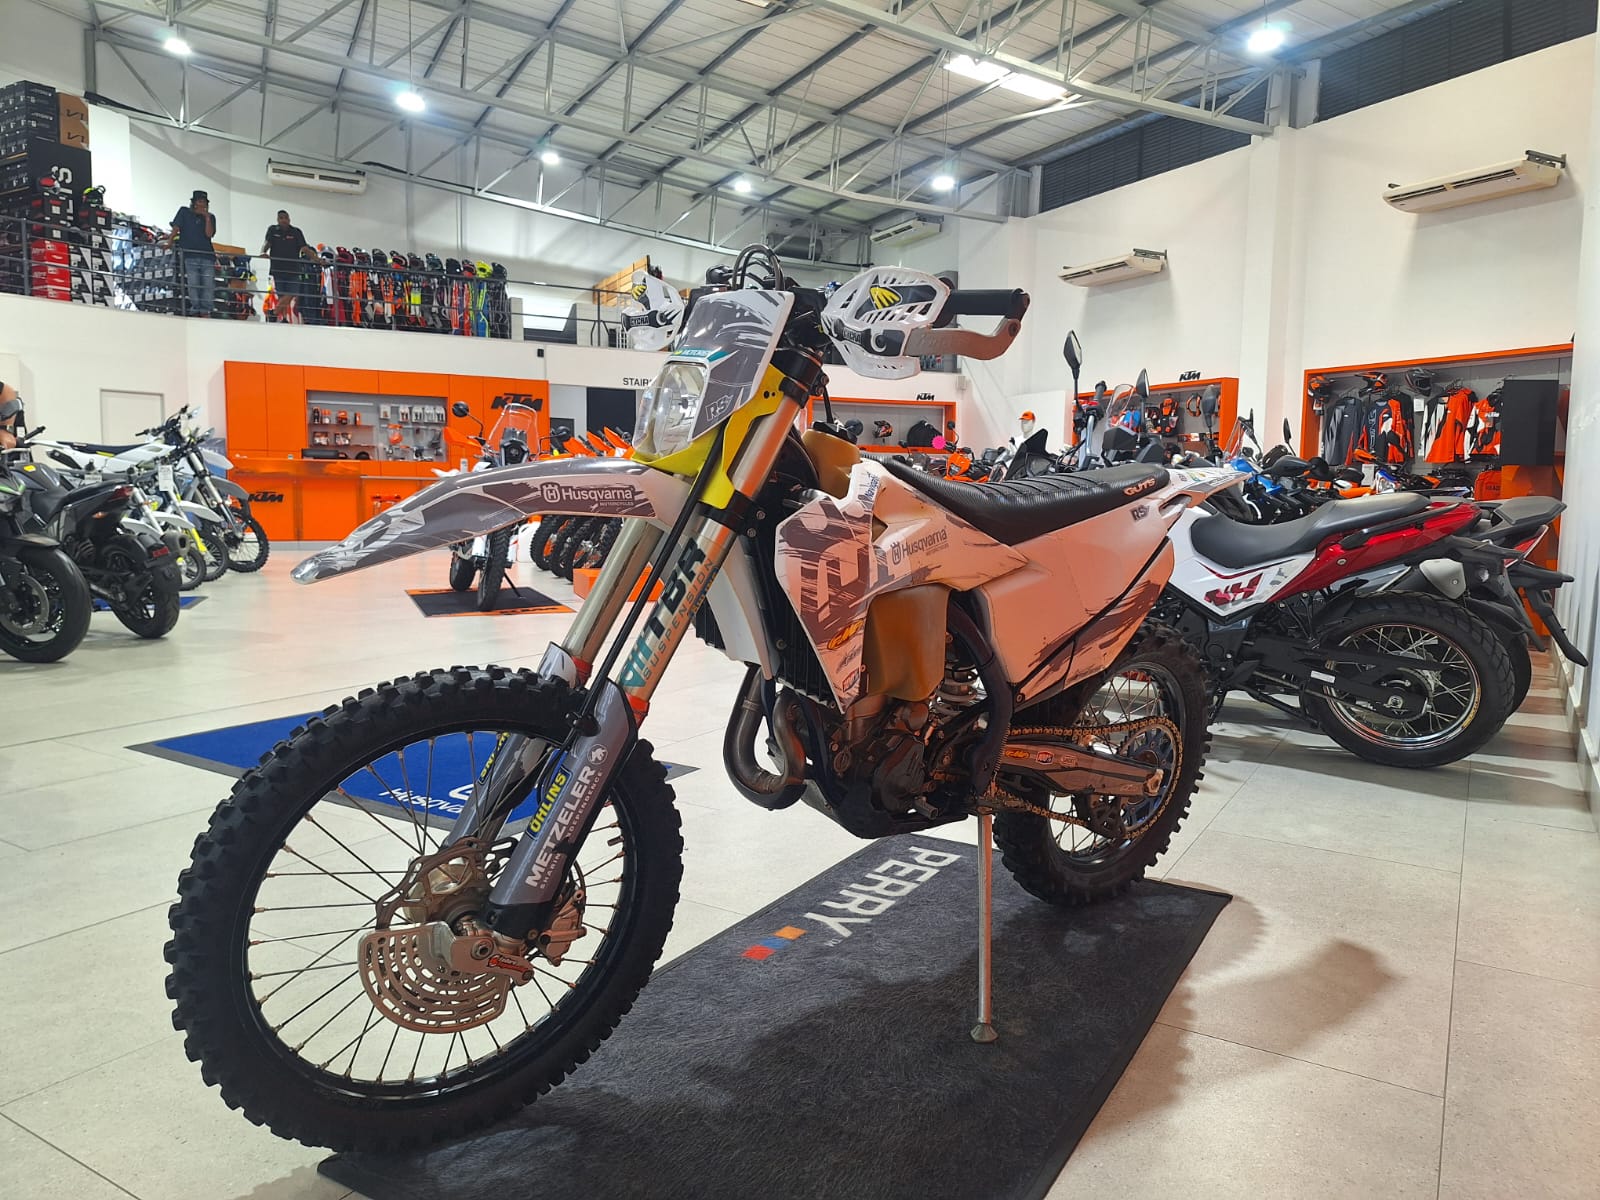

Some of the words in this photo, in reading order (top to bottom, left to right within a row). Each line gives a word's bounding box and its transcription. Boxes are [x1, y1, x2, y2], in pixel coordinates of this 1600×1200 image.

[622, 377, 651, 387] STAIR
[1179, 370, 1201, 382] KTM
[491, 392, 543, 412] KTM
[916, 392, 935, 401] KTM
[248, 491, 284, 502] KTM
[562, 487, 634, 501] Husqvarna
[1123, 477, 1156, 496] GUTS
[901, 529, 948, 558] Husqvarna
[642, 558, 717, 681] SUSPENSION
[378, 787, 465, 814] Husqva
[530, 772, 567, 833] ÖHLINS
[525, 765, 596, 888] METZELER
[540, 852, 561, 889] SHARIN
[565, 771, 603, 838] NDEPENDENCE
[803, 845, 962, 938] PERRY
